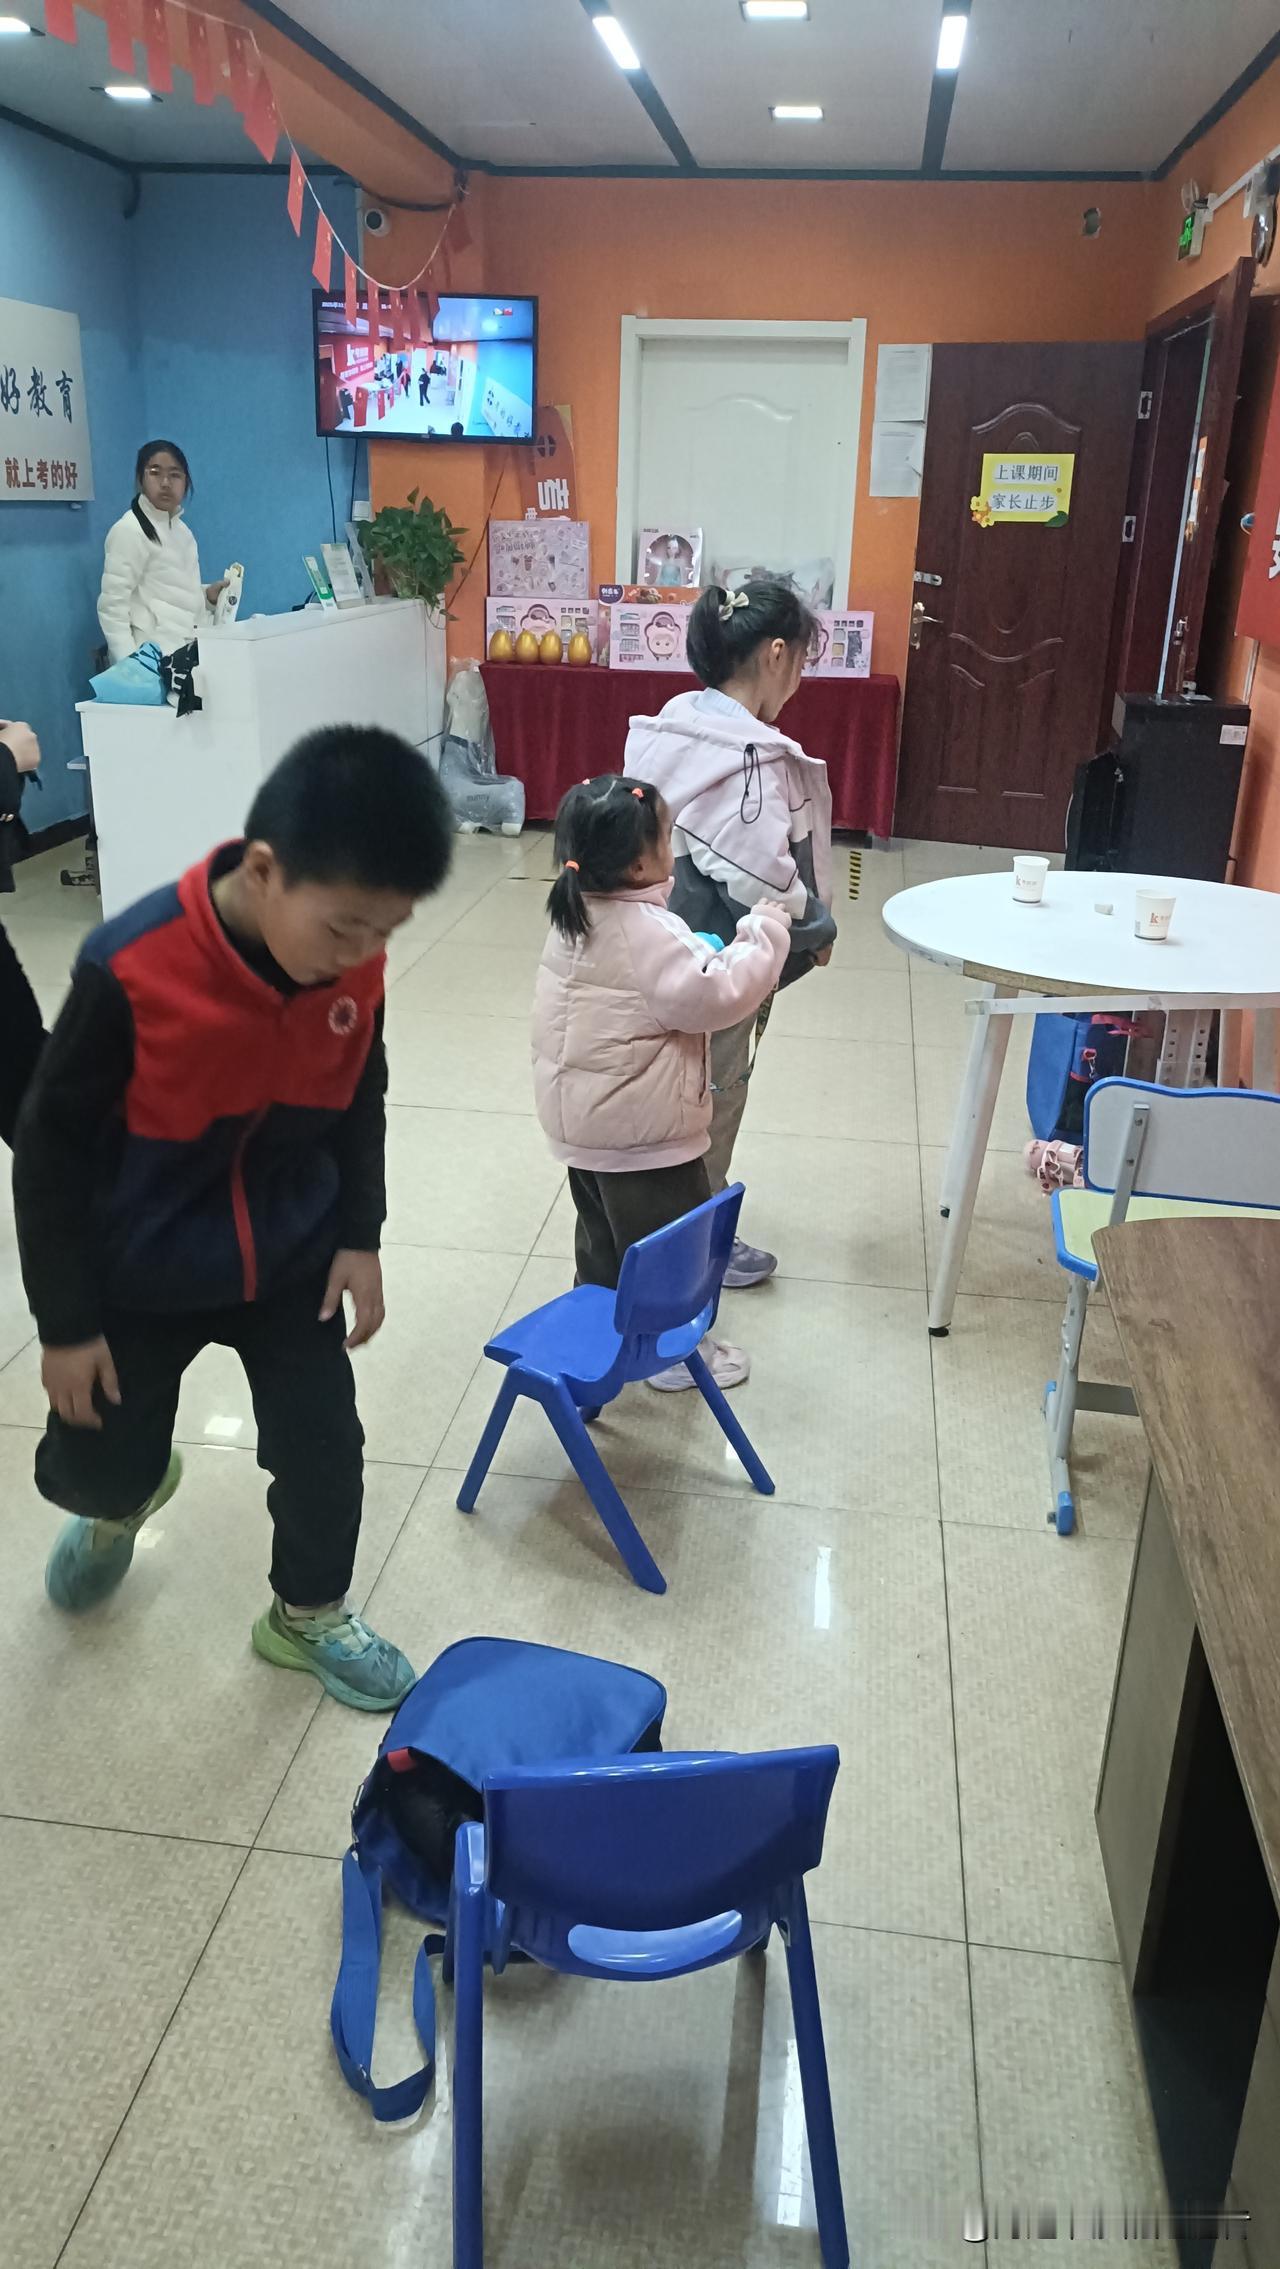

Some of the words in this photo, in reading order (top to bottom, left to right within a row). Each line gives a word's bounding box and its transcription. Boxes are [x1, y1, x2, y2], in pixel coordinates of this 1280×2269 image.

[0, 364, 74, 424] 好教育
[4, 456, 79, 491] 就上考的好
[994, 464, 1059, 482] 上课期间
[991, 493, 1056, 512] 家长止步
